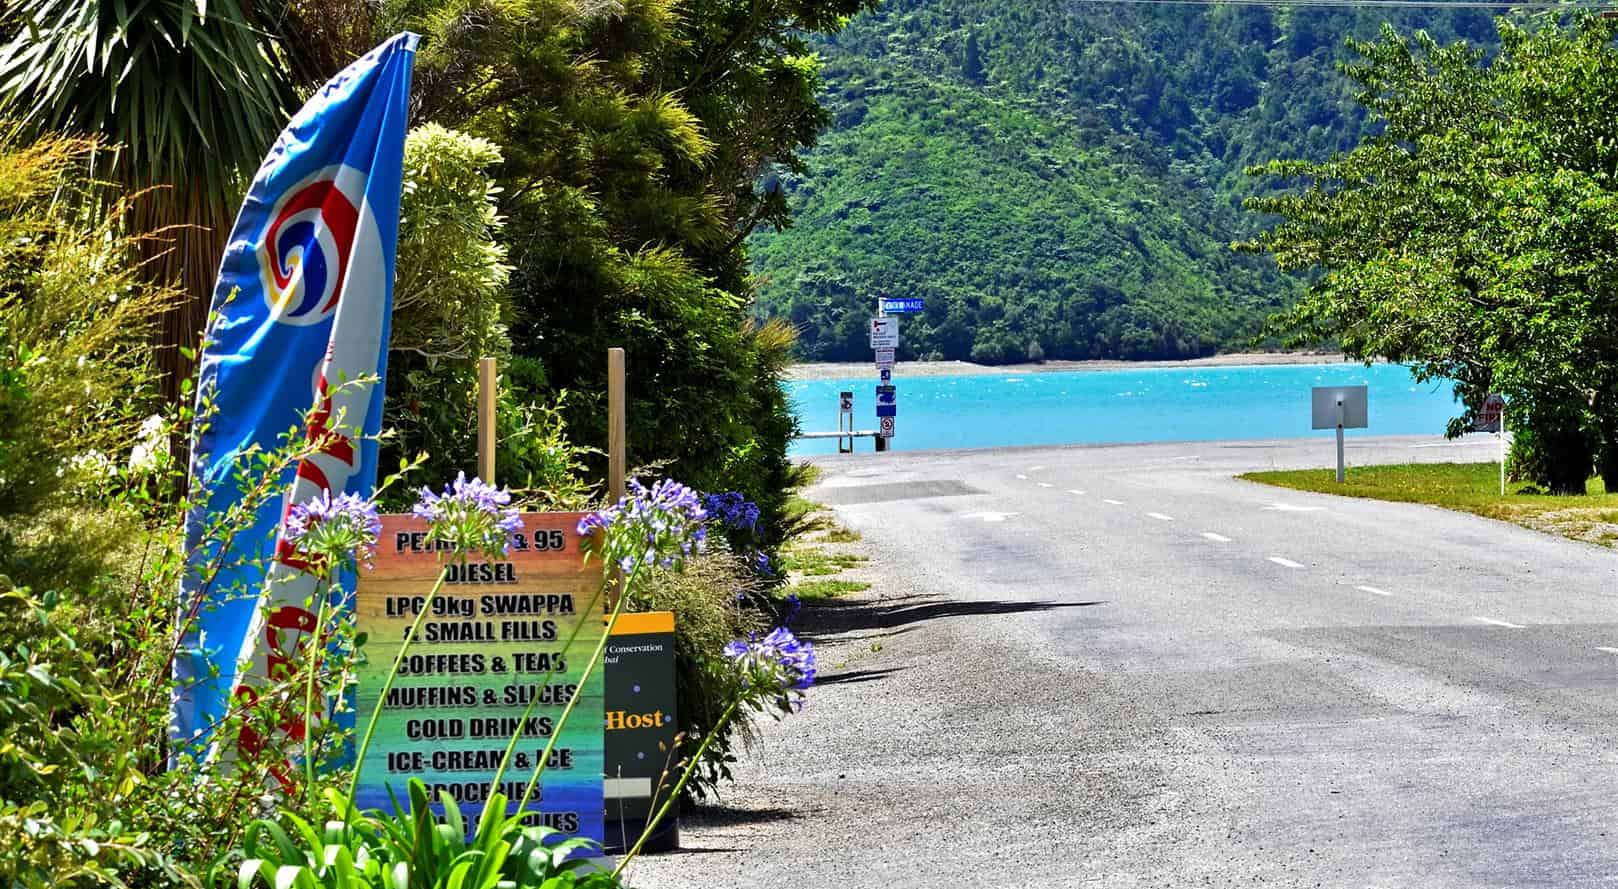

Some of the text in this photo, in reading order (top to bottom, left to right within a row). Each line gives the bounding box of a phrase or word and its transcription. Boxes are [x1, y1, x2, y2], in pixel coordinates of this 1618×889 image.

[1478, 413, 1502, 422] FIR
[396, 532, 477, 551] PETR
[534, 530, 564, 549] 95
[445, 563, 516, 582] DIESEL
[386, 594, 574, 616] LPG 9kg SWAPPA
[426, 622, 495, 641] SMALL
[502, 620, 556, 639] FILLS
[609, 644, 663, 653] Conservation
[394, 653, 566, 673] COFFEES & TEAS
[381, 684, 579, 706] MUFFINS & SLICES
[407, 717, 553, 738] COLD DRINKS
[606, 710, 664, 730] Host
[388, 749, 572, 771] ICE-CREAM & ICE
